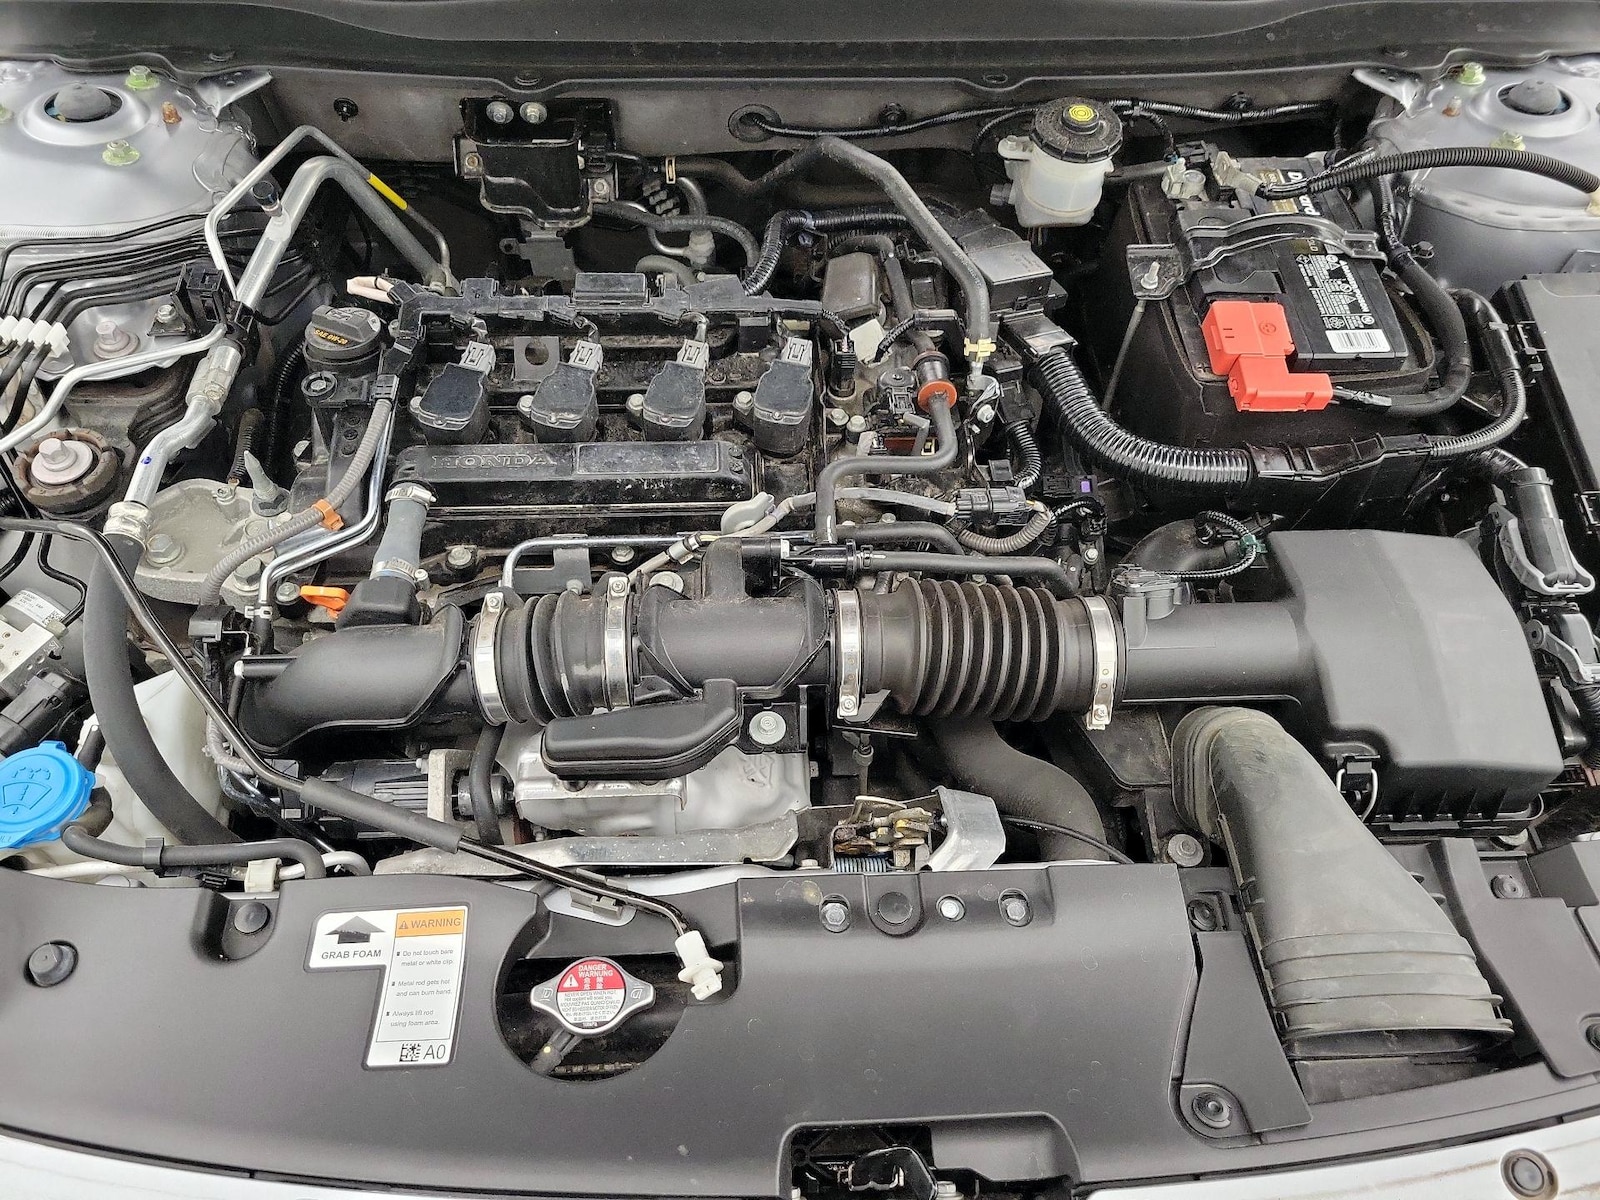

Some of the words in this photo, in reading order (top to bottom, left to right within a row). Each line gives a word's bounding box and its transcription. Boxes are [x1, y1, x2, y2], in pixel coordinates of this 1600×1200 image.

[314, 329, 329, 338] SAE
[431, 453, 558, 469] HONDA
[411, 918, 461, 928] WARNING
[321, 951, 350, 960] GRAB
[352, 949, 382, 958] FOAM
[578, 963, 607, 971] DANGER
[578, 969, 613, 978] WARNUNG
[426, 979, 439, 987] gets
[390, 1020, 407, 1028] using
[423, 1044, 446, 1060] A0
